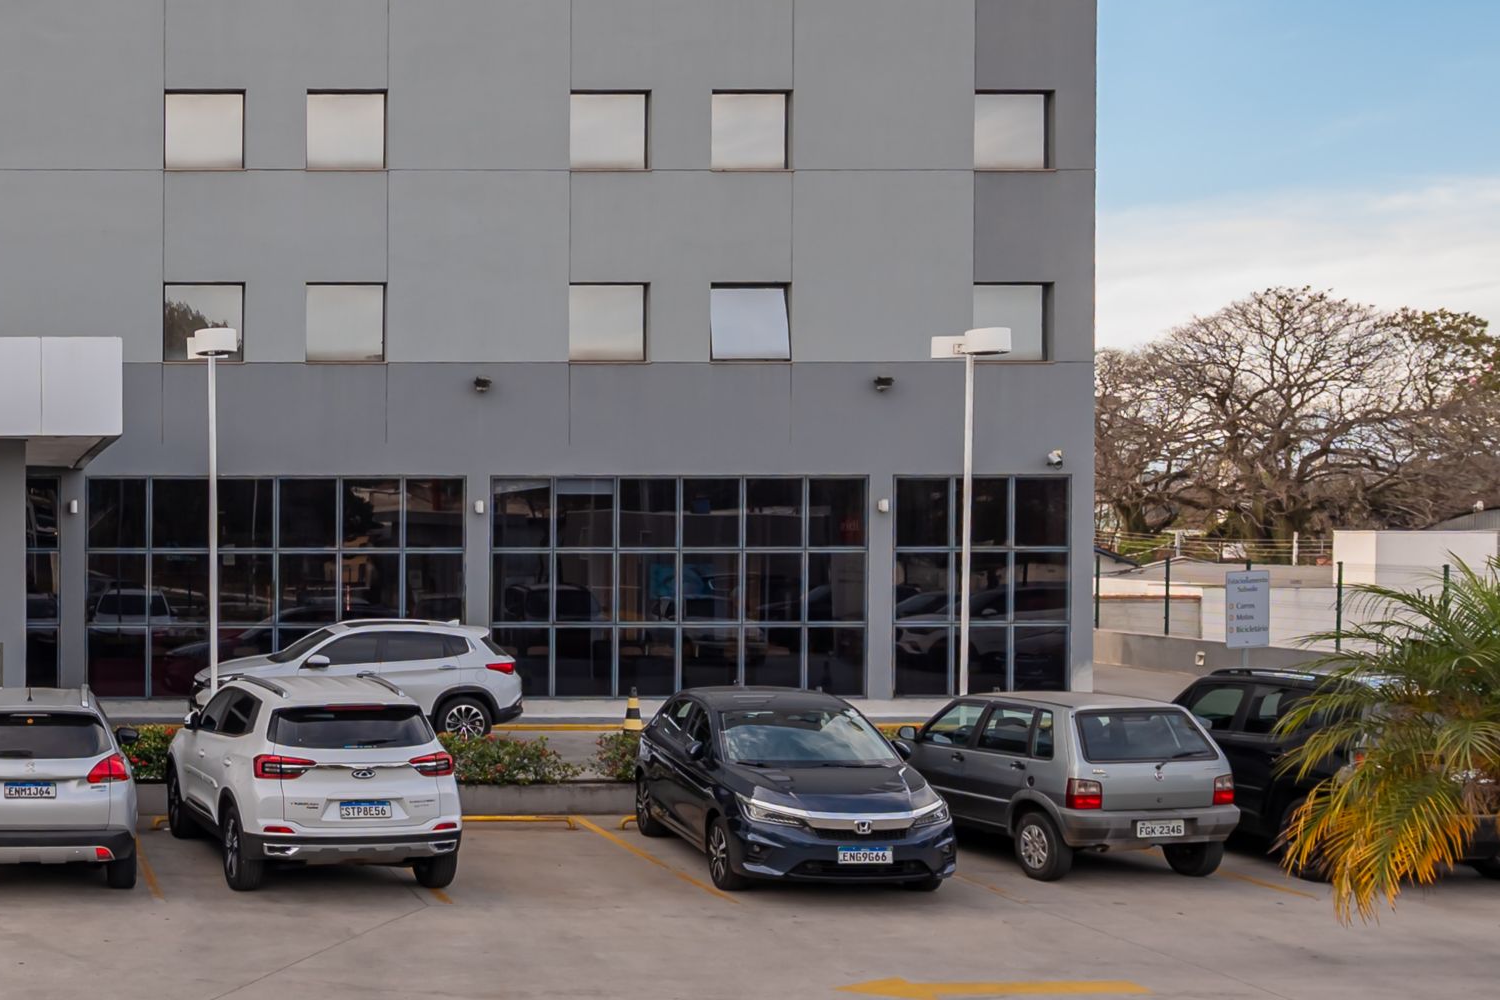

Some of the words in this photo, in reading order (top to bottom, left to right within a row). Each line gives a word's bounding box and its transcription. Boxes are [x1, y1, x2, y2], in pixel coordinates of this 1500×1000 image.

[8, 786, 51, 796] ENM1J64
[345, 806, 387, 817] STP8E56
[842, 851, 887, 862] ENG9G66
